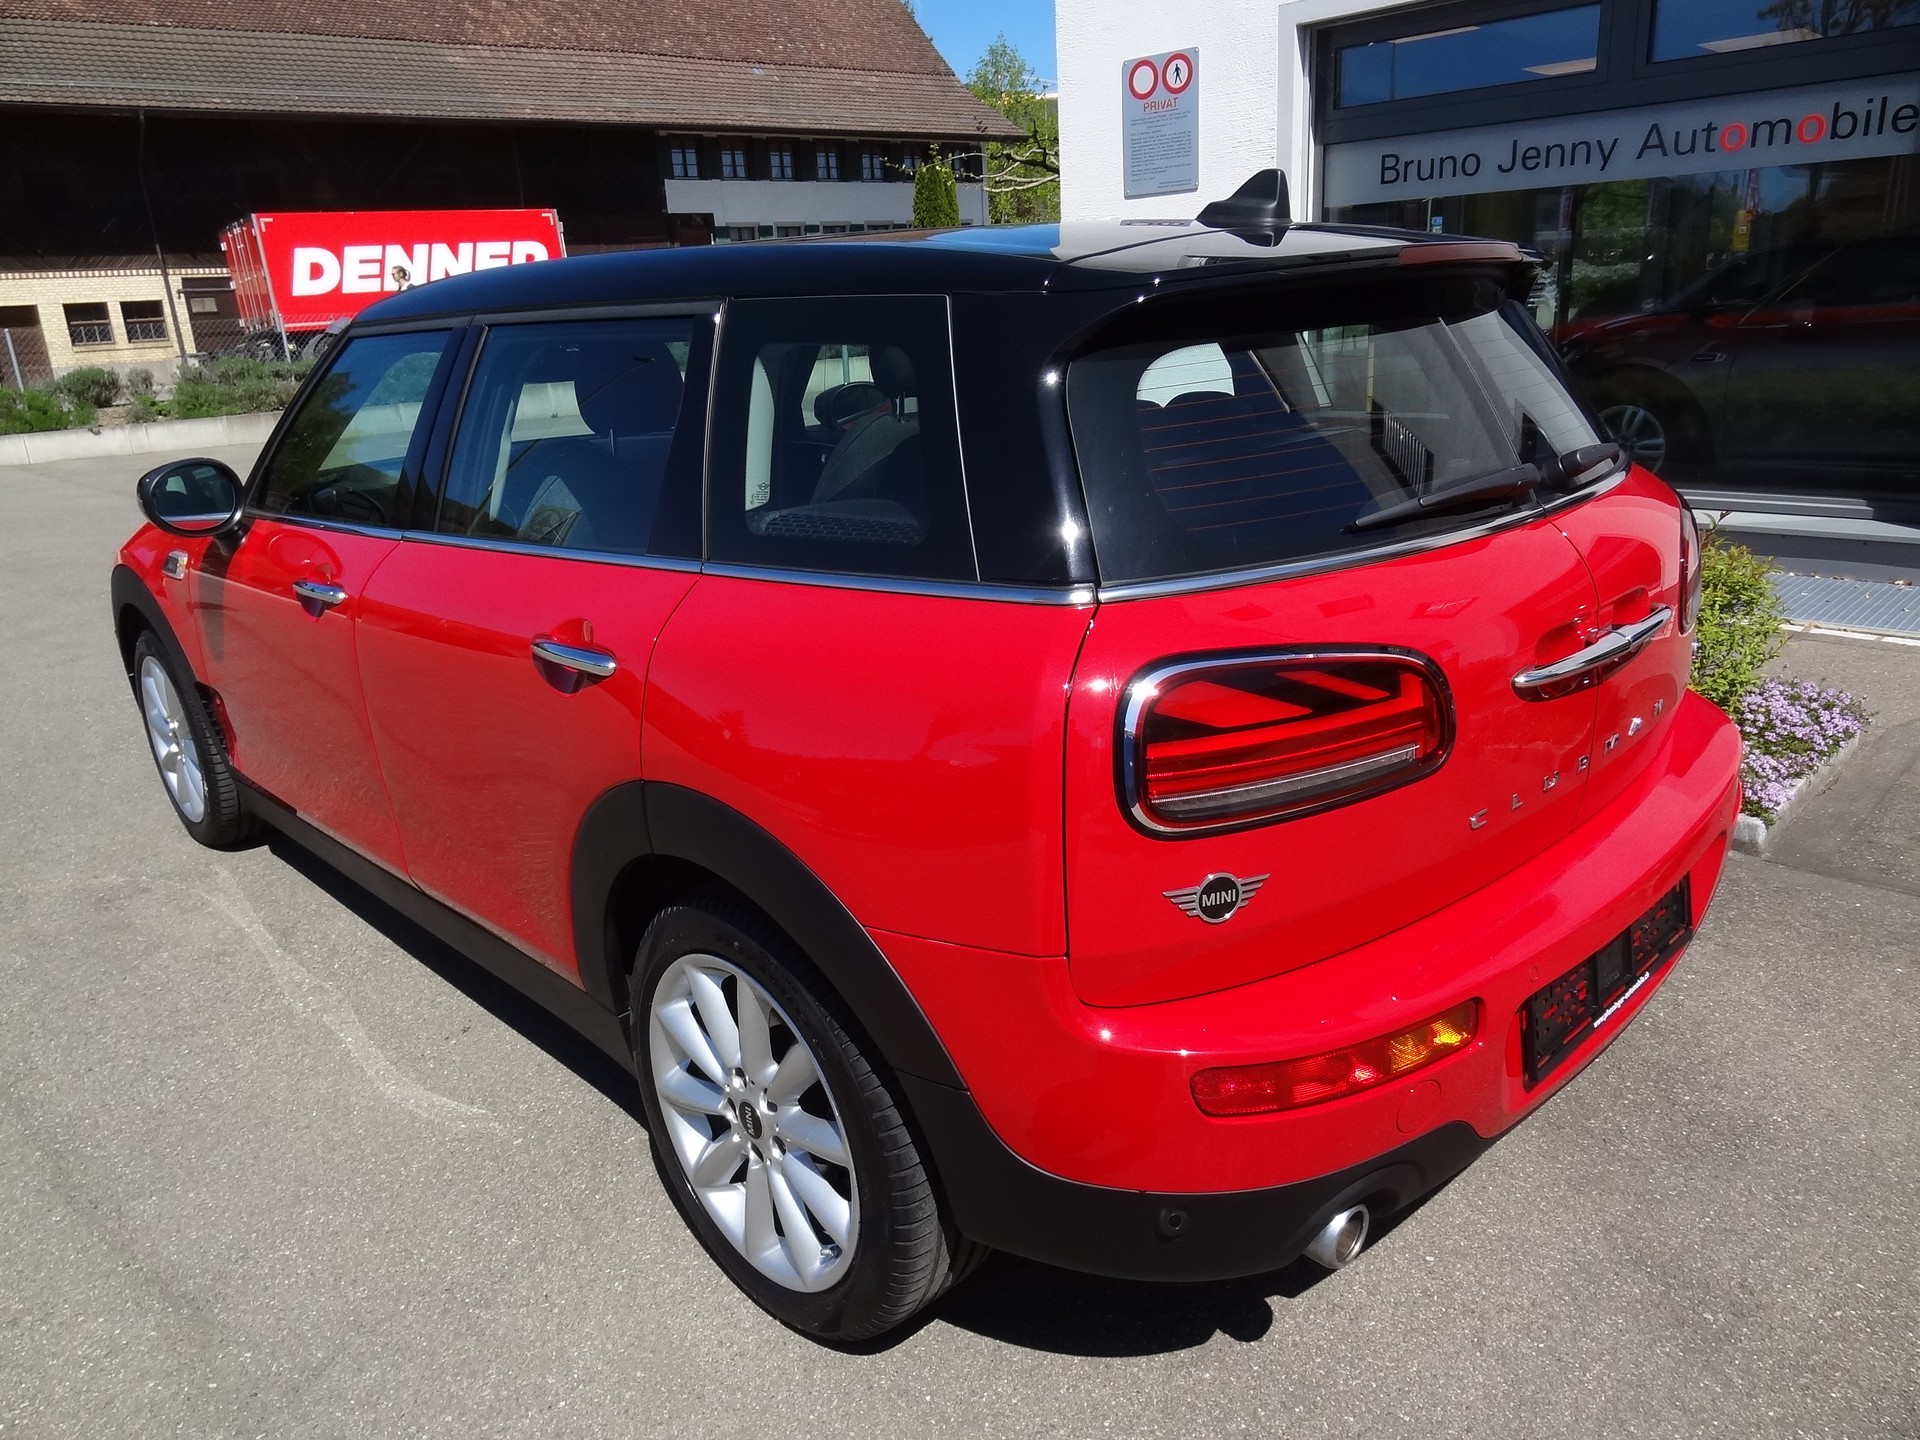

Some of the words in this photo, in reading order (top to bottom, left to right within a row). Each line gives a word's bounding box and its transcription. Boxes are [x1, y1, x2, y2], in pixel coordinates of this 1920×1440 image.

[1143, 97, 1179, 112] PRIVAT
[1380, 152, 1481, 185] Bruno
[1497, 137, 1620, 174] Jenny
[1635, 95, 1919, 160] Automobile
[1202, 888, 1237, 907] MINI
[744, 1106, 755, 1136] MINI
